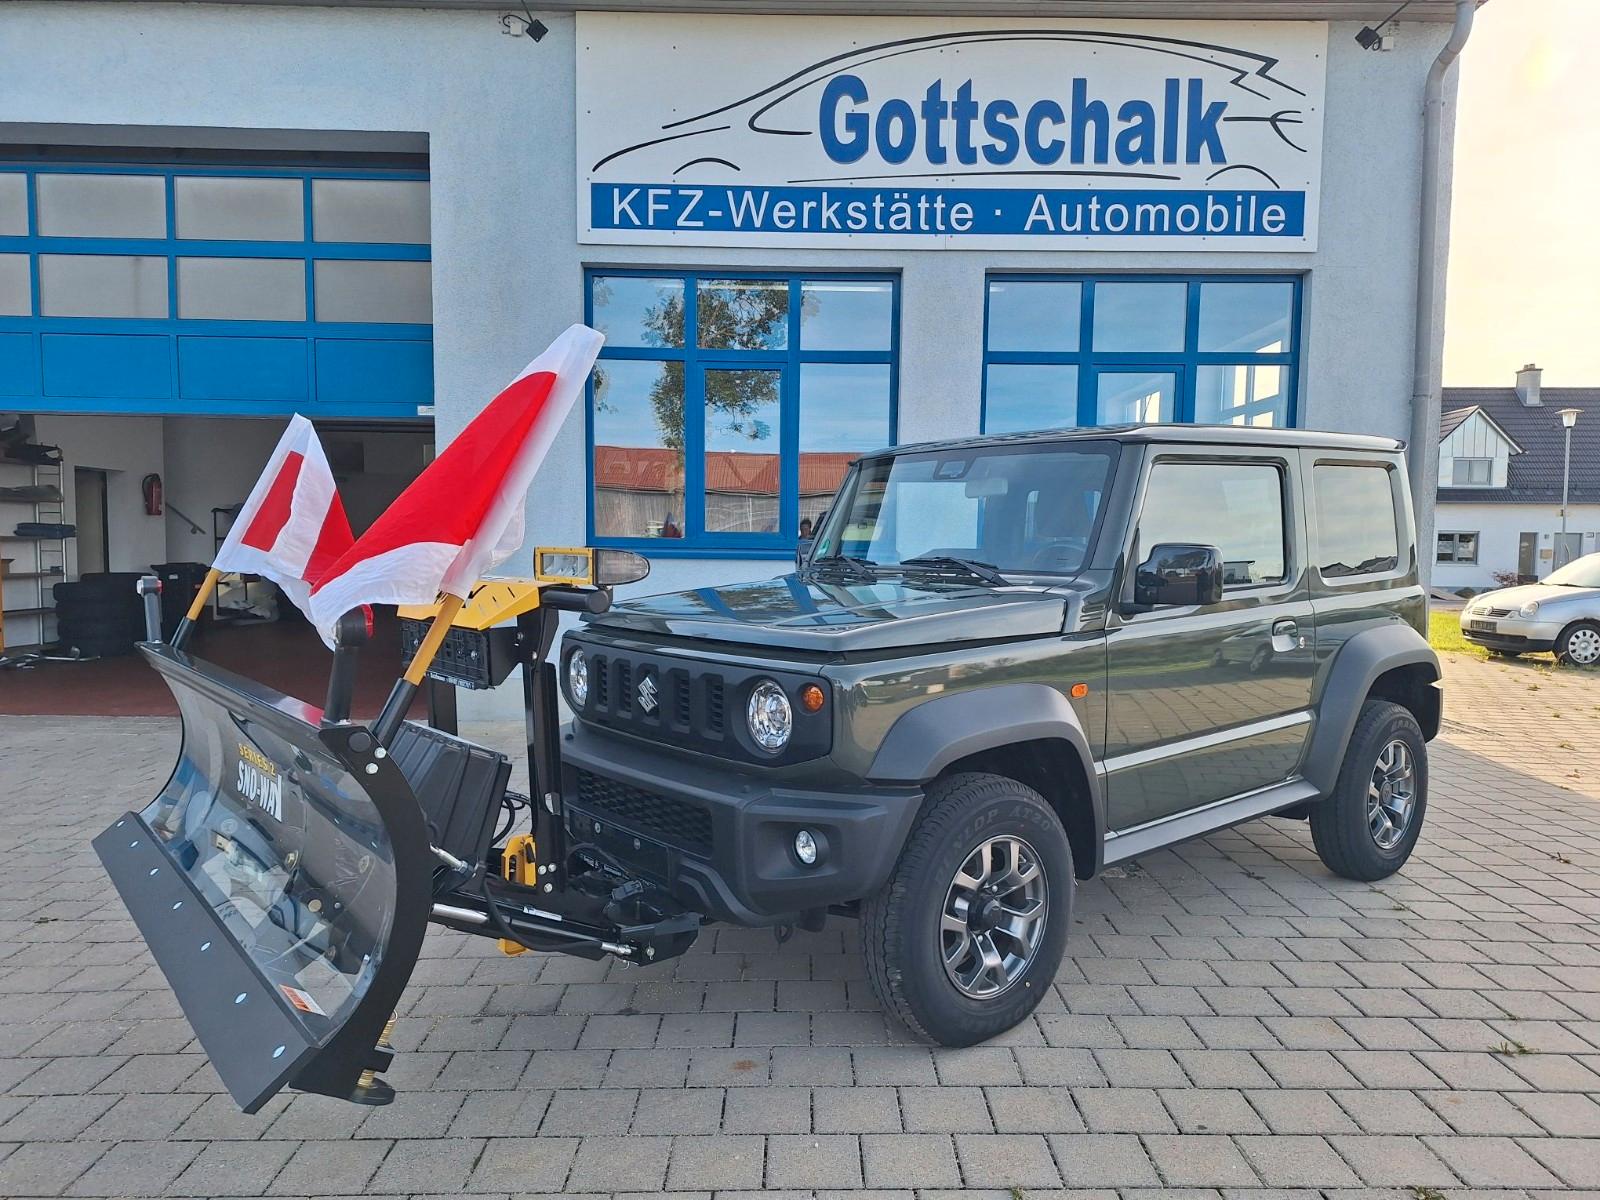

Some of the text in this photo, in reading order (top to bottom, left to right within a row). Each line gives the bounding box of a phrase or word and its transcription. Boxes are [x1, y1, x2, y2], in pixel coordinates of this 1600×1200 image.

[820, 75, 1227, 167] Gottschalk
[611, 188, 1286, 234] KFZ-Werkstätte Automobile
[237, 760, 282, 822] SNO-WAY
